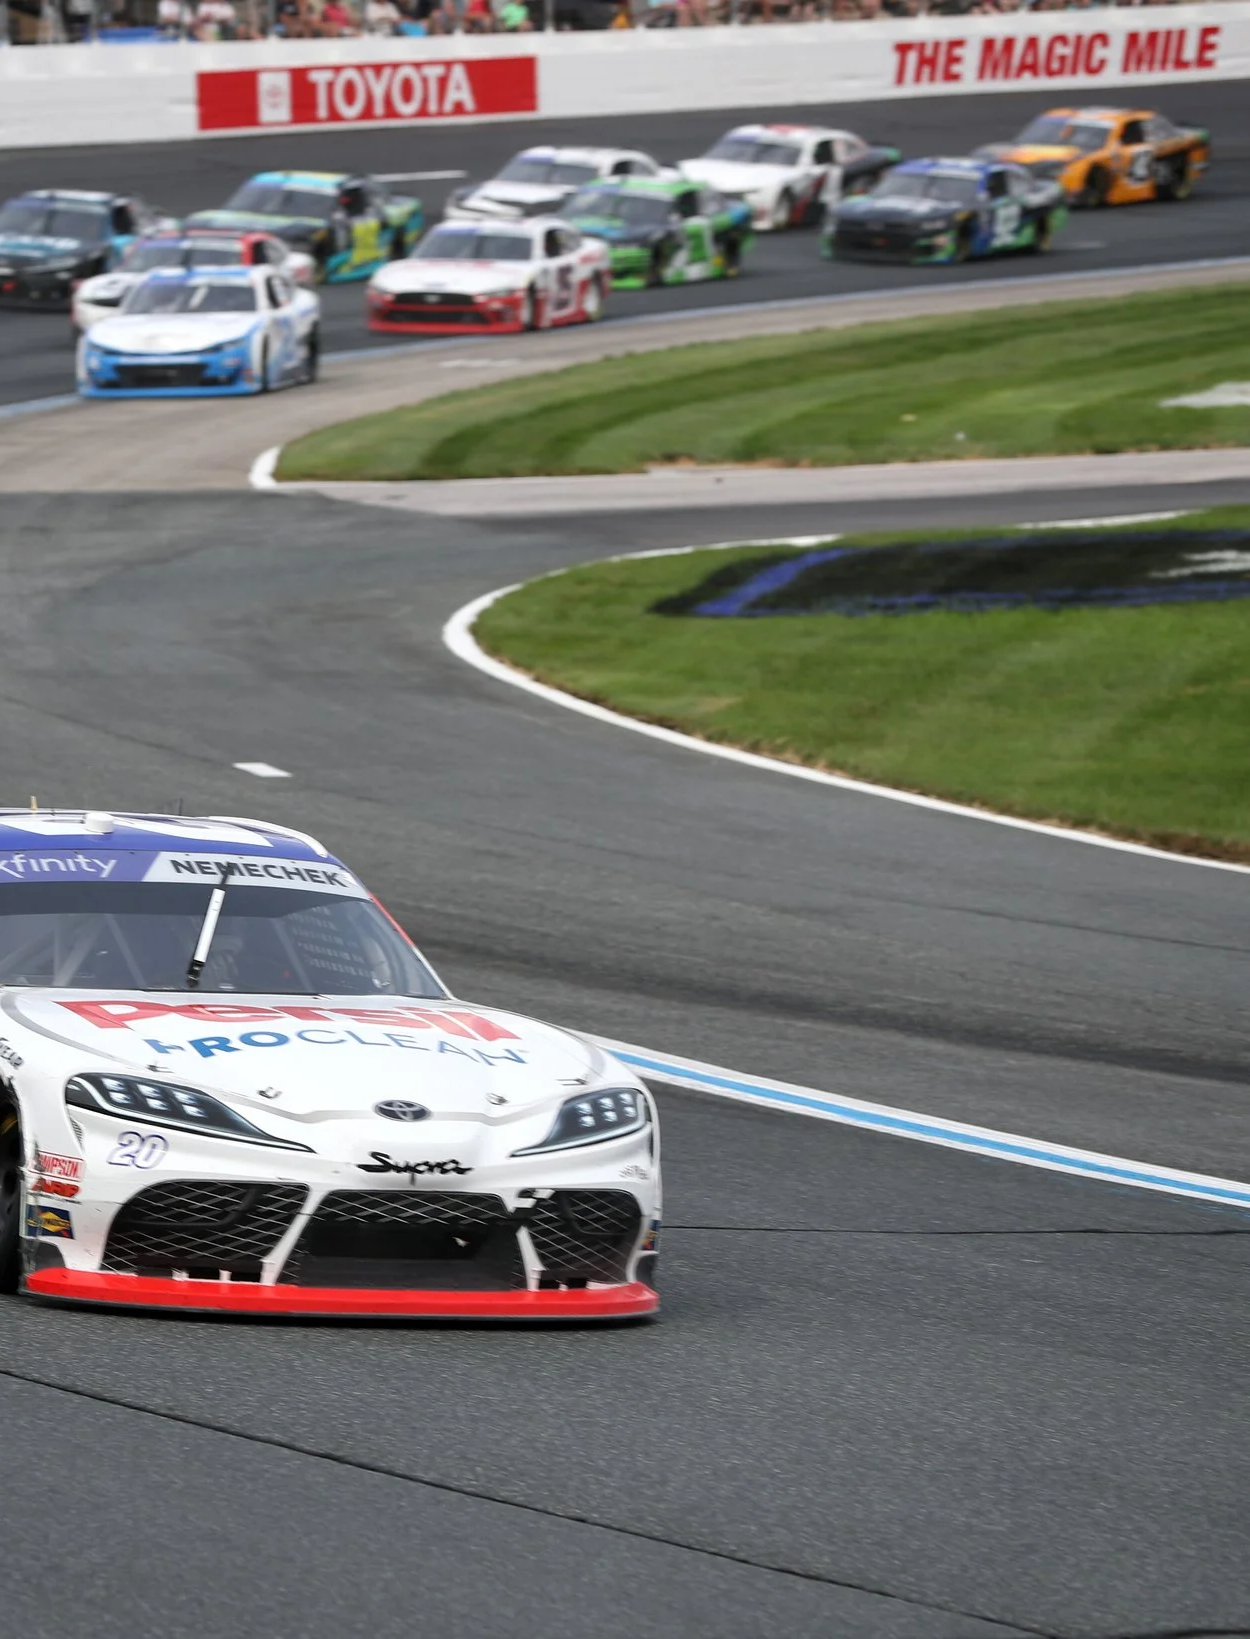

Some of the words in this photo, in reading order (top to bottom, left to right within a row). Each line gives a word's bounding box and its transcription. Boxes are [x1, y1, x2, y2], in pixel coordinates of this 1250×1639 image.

[894, 39, 966, 86] THE
[977, 33, 1110, 81] MAGIC
[1121, 25, 1221, 73] MILE
[307, 64, 477, 120] TOYOTA
[170, 857, 350, 888] NEMECHEK
[53, 1000, 519, 1042] Persil
[107, 1131, 168, 1169] 20
[356, 1151, 473, 1186] Supra
